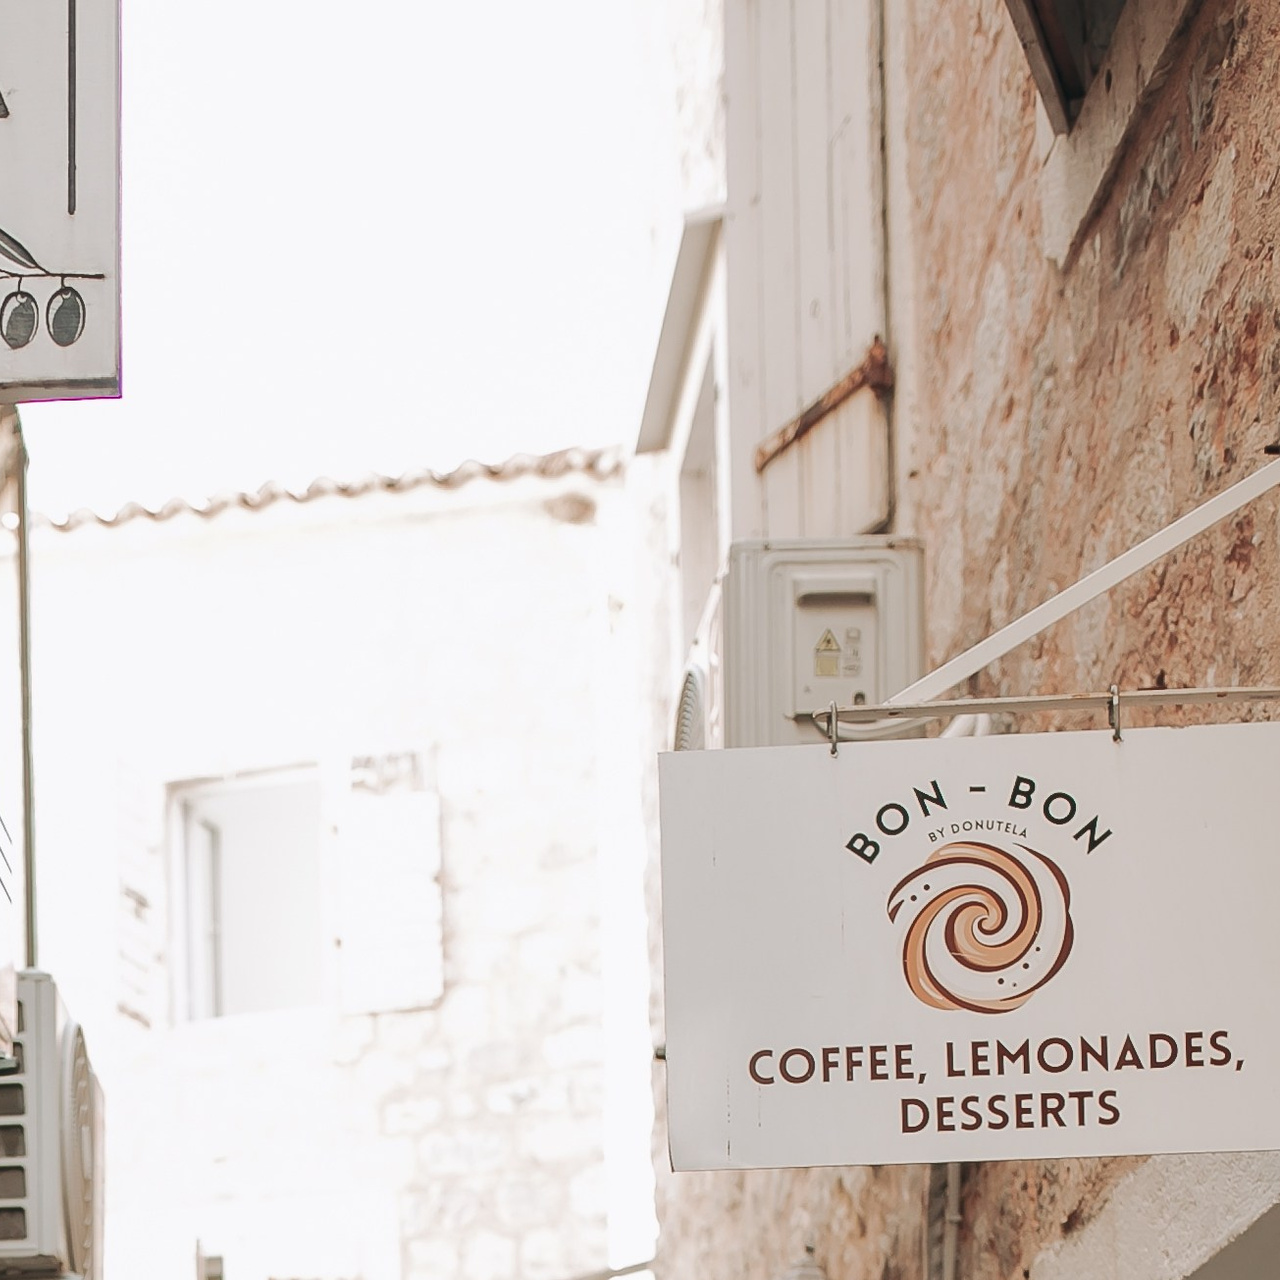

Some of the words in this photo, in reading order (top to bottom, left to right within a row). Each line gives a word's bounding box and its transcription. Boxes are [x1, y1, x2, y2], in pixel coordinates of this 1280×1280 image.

[845, 779, 948, 865] BON
[1007, 775, 1114, 855] BON
[927, 826, 945, 843] BY
[950, 819, 1027, 839] DONUTELA
[748, 1043, 927, 1085] COFFEE,
[945, 1030, 1245, 1078] LEMONADES,
[900, 1089, 1121, 1134] DESSERTS
